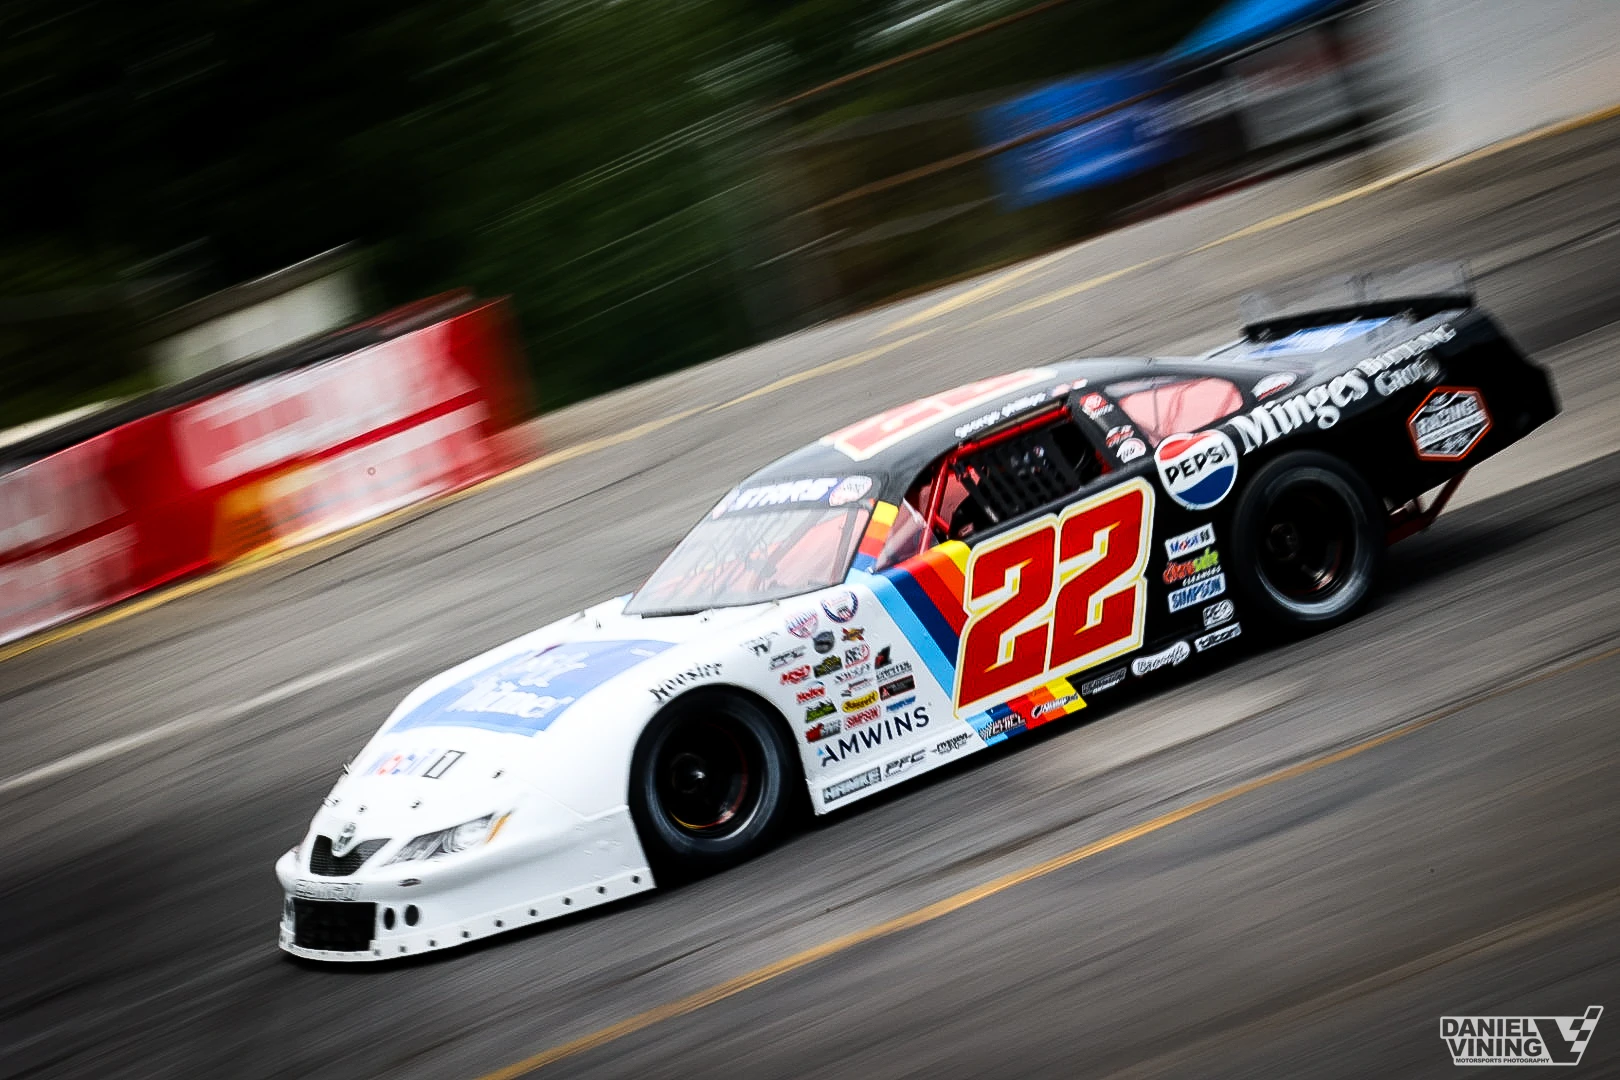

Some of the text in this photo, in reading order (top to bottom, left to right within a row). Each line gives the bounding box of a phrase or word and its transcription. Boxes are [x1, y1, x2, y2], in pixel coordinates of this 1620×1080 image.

[1232, 369, 1368, 455] Minges
[1165, 442, 1232, 485] PEPSI
[957, 486, 1145, 711] 22
[1171, 576, 1222, 610] SIMPSON
[817, 705, 931, 768] AMWINS
